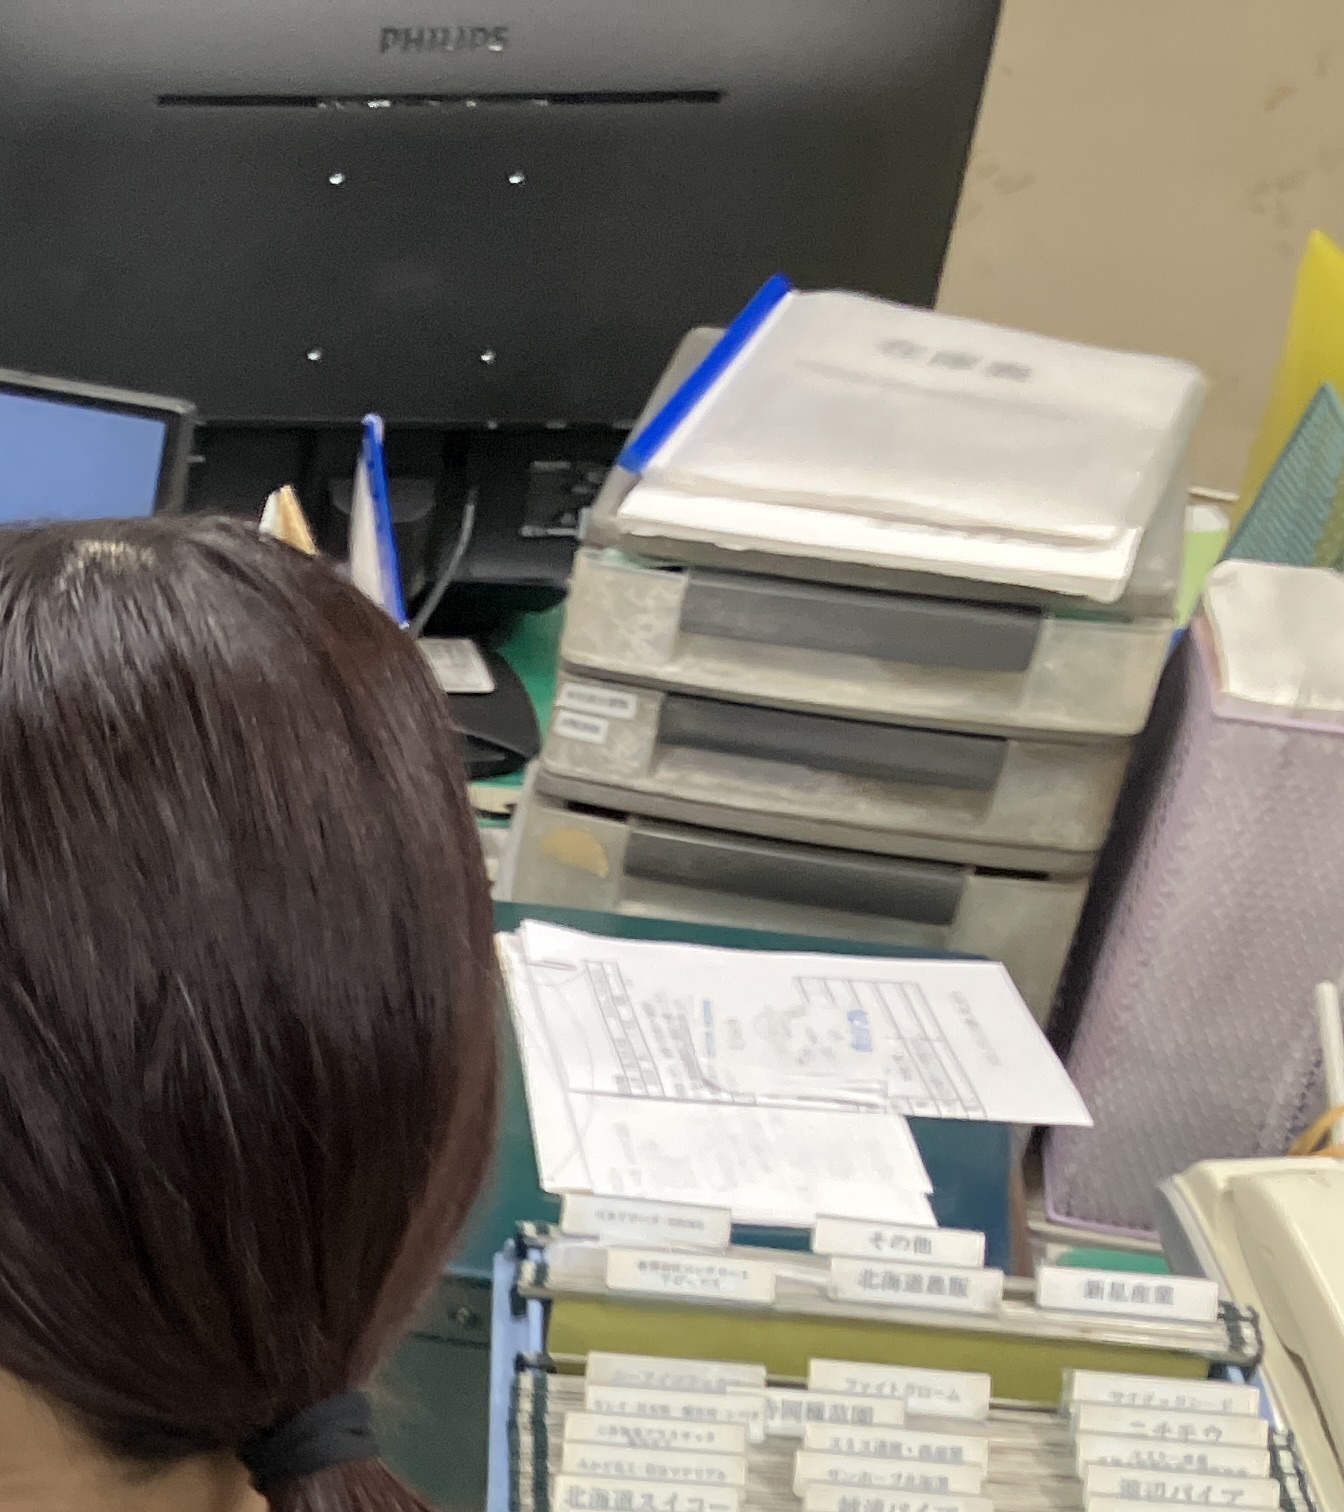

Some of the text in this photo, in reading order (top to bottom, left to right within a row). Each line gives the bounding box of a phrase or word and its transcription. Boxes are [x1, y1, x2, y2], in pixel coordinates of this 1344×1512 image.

[379, 26, 509, 53] PHILIPS
[869, 1231, 932, 1255] その他
[566, 1485, 730, 1512] 北海道スイコー
